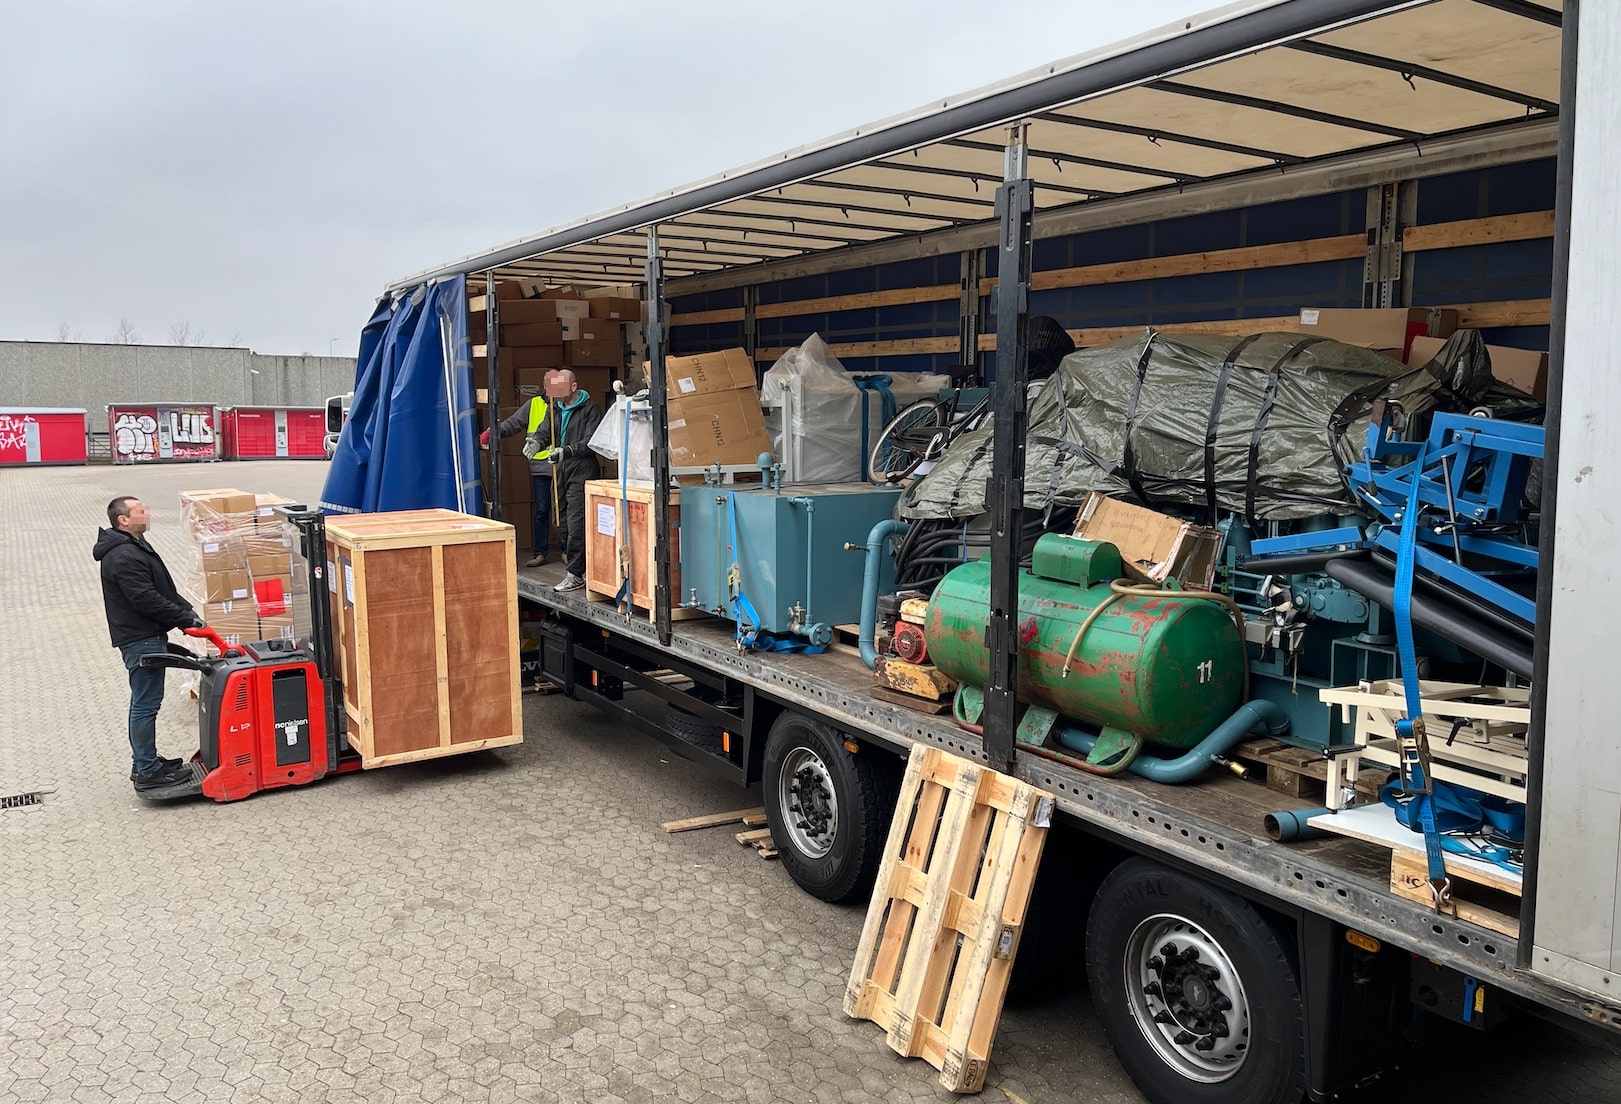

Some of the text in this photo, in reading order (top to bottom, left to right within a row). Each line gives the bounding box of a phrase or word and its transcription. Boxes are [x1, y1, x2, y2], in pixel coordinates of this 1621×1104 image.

[691, 357, 707, 383] CHN12
[711, 420, 726, 448] CHN12
[1196, 659, 1213, 684] 11
